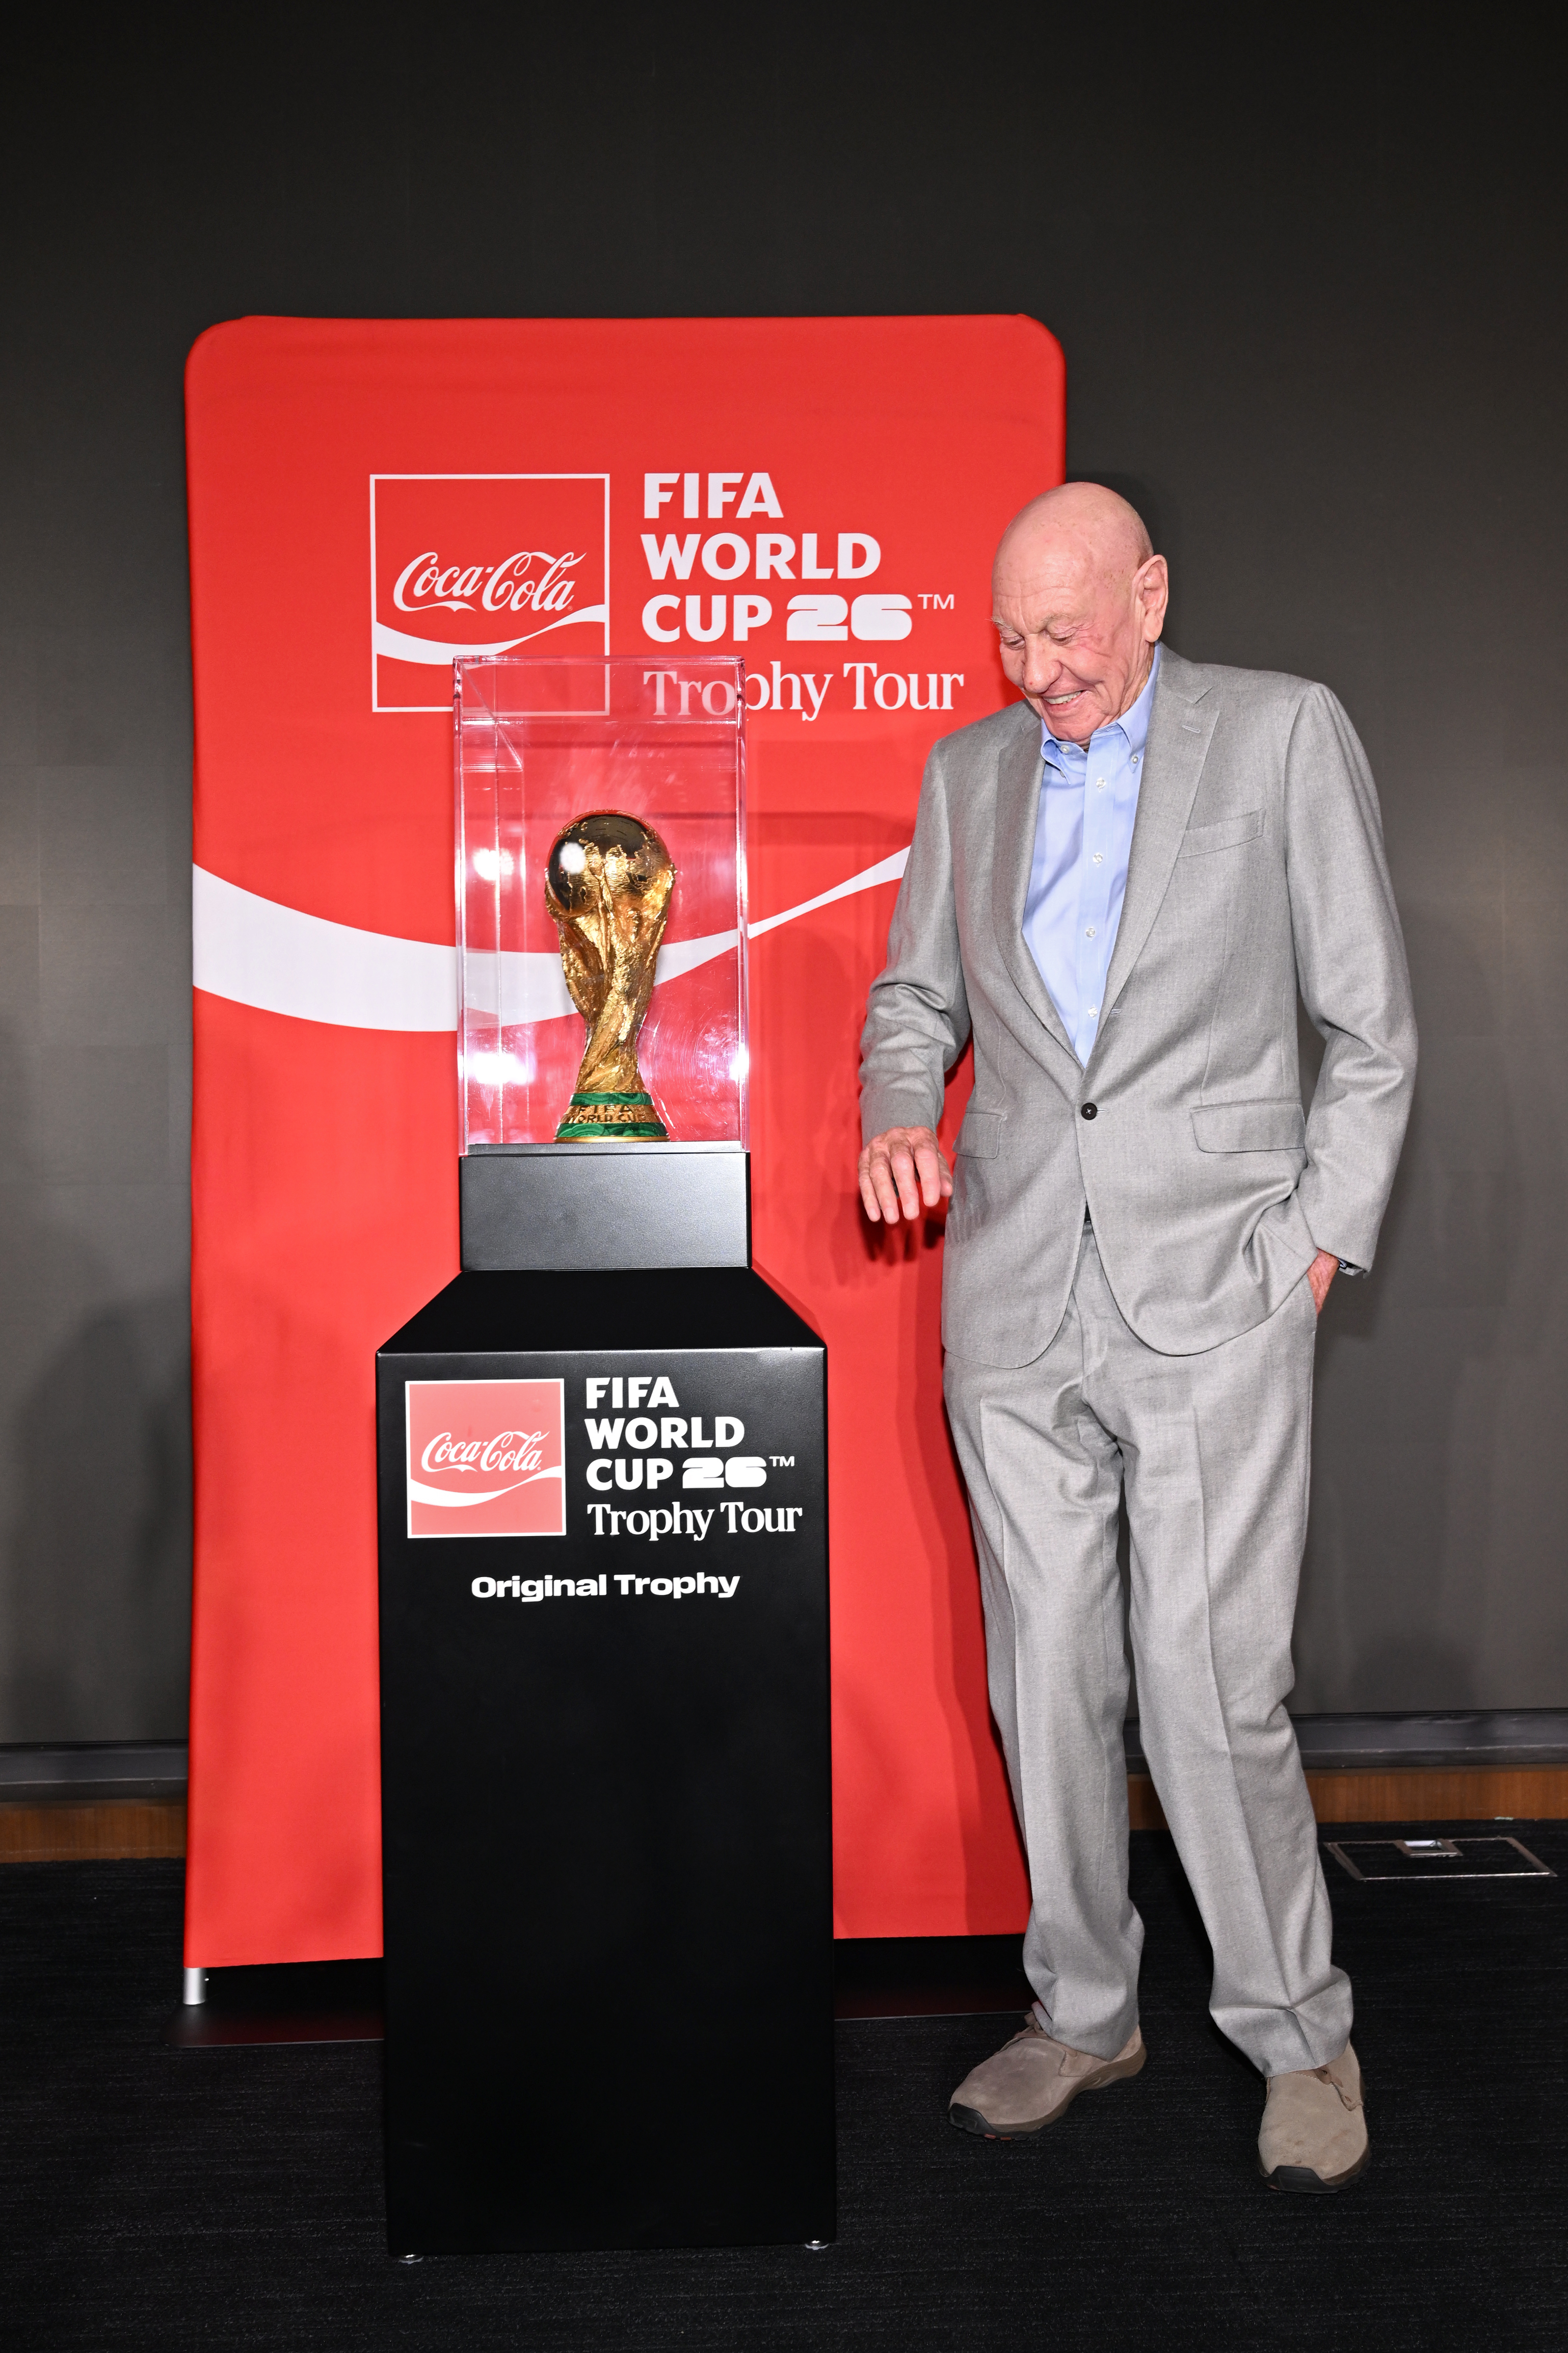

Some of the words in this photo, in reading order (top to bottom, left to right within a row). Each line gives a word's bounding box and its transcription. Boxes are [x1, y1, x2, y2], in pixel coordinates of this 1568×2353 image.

[644, 472, 784, 519] FIFA
[640, 532, 881, 581] WORLD
[393, 552, 587, 612] Coca-Cola
[642, 594, 773, 643] CUP
[843, 663, 964, 710] Tour
[579, 1105, 633, 1114] FIFA
[618, 1114, 646, 1122] CUP
[586, 1376, 680, 1409] FIFA
[421, 1431, 550, 1472] Coca-Cola
[584, 1416, 745, 1450] WORLD
[586, 1458, 674, 1491] CUP
[587, 1501, 715, 1541] Trophy
[720, 1501, 803, 1533] Tour
[471, 1574, 607, 1602] Original
[614, 1572, 740, 1599] Trophy
